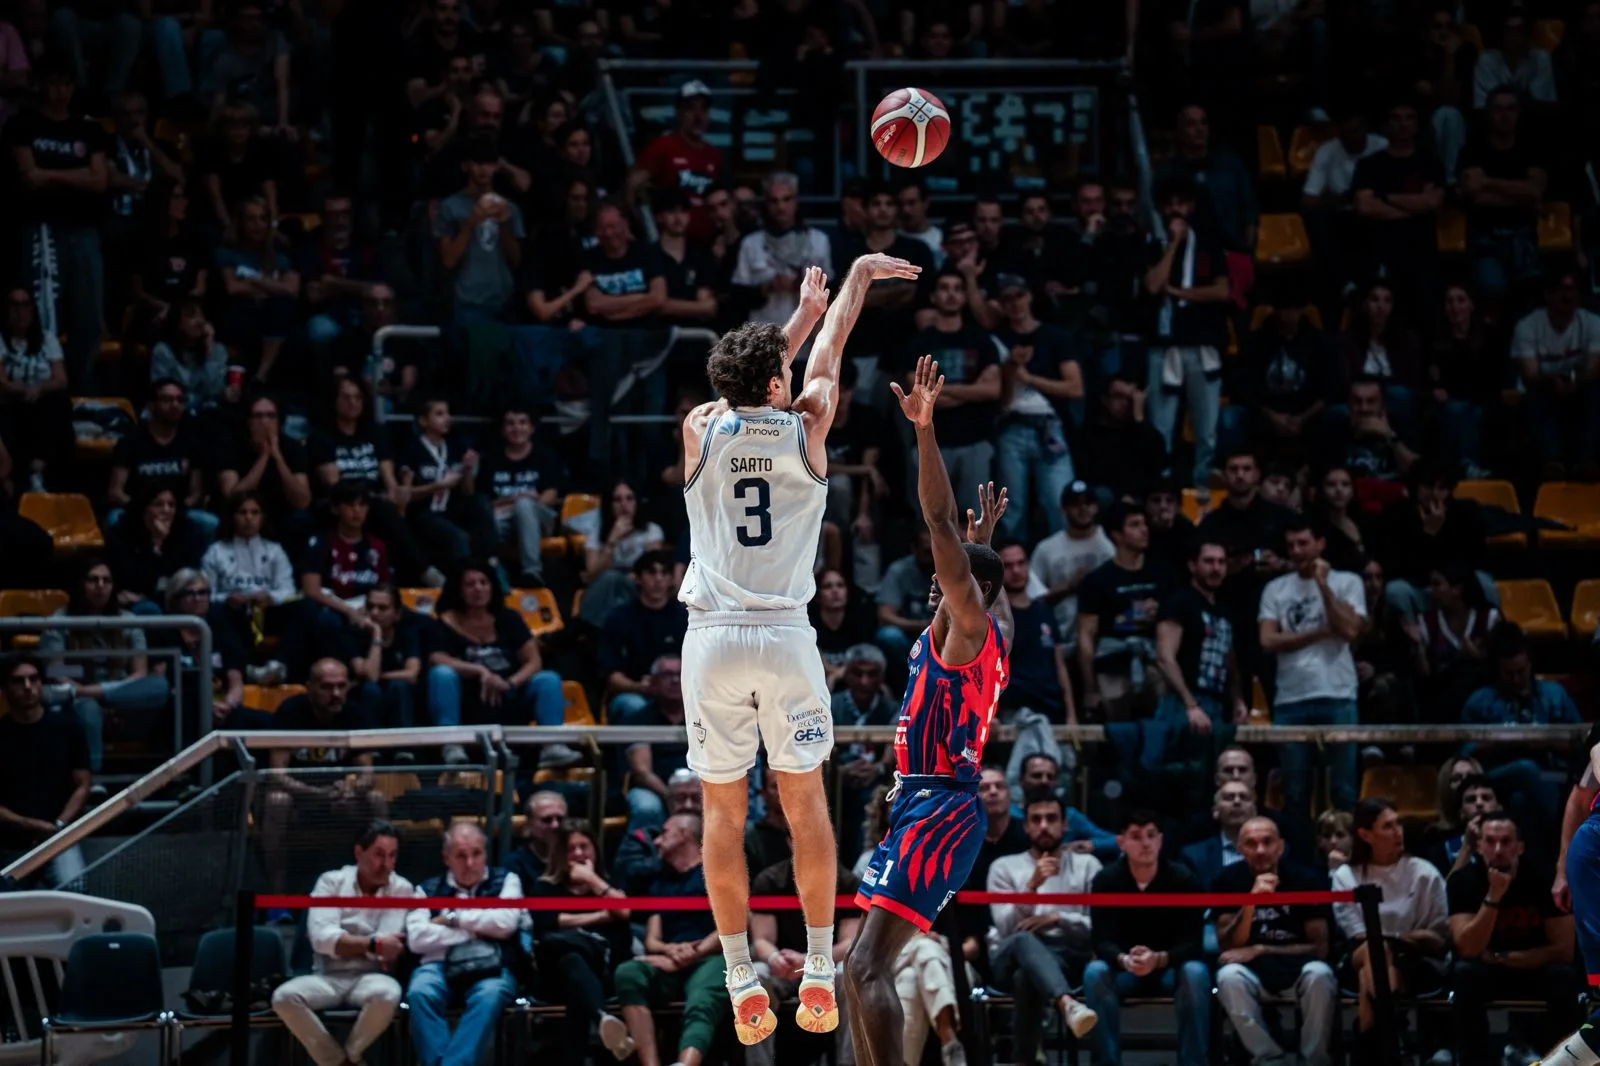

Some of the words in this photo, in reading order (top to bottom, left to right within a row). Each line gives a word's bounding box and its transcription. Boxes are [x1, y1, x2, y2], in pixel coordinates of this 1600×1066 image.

[745, 426, 780, 437] Innova
[730, 457, 773, 473] SARTO
[733, 477, 773, 548] 3
[794, 726, 825, 742] GEA
[878, 859, 895, 887] 1
